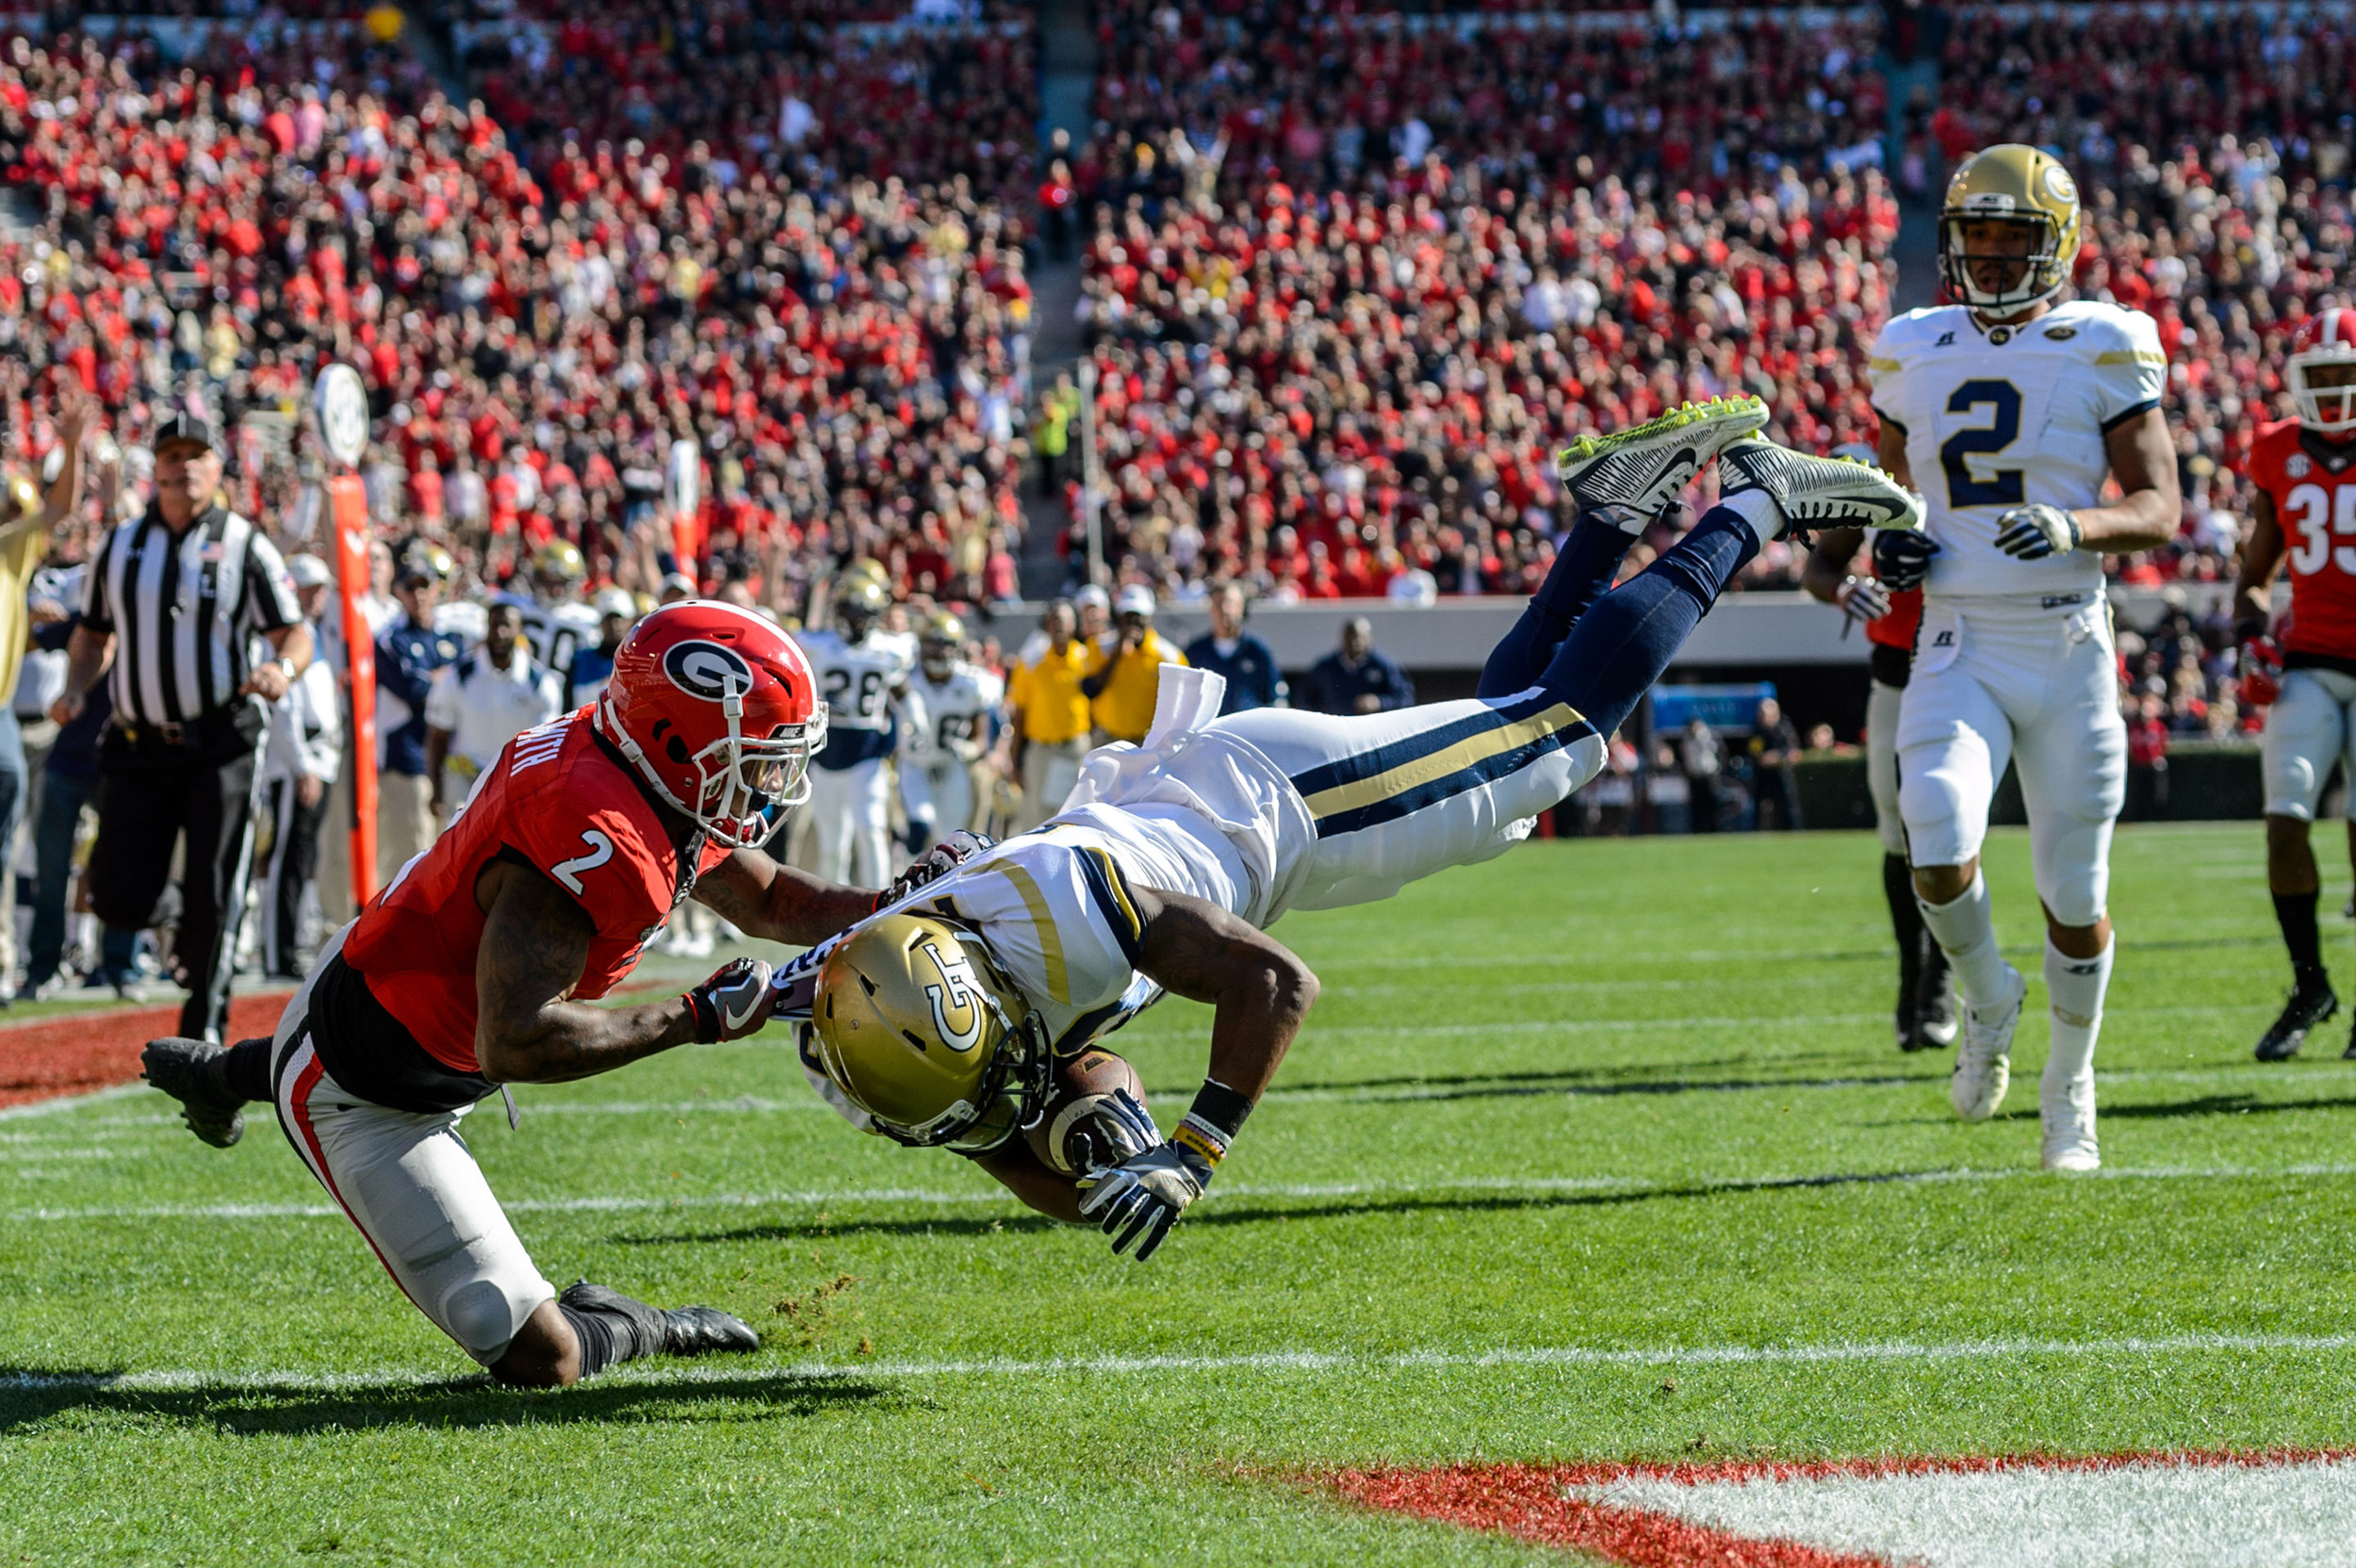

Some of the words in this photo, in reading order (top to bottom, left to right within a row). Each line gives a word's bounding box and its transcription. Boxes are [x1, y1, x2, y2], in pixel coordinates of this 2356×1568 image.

[1939, 378, 2026, 511] 2
[2285, 482, 2356, 576] 35
[663, 639, 754, 703] G
[550, 829, 614, 894] 2
